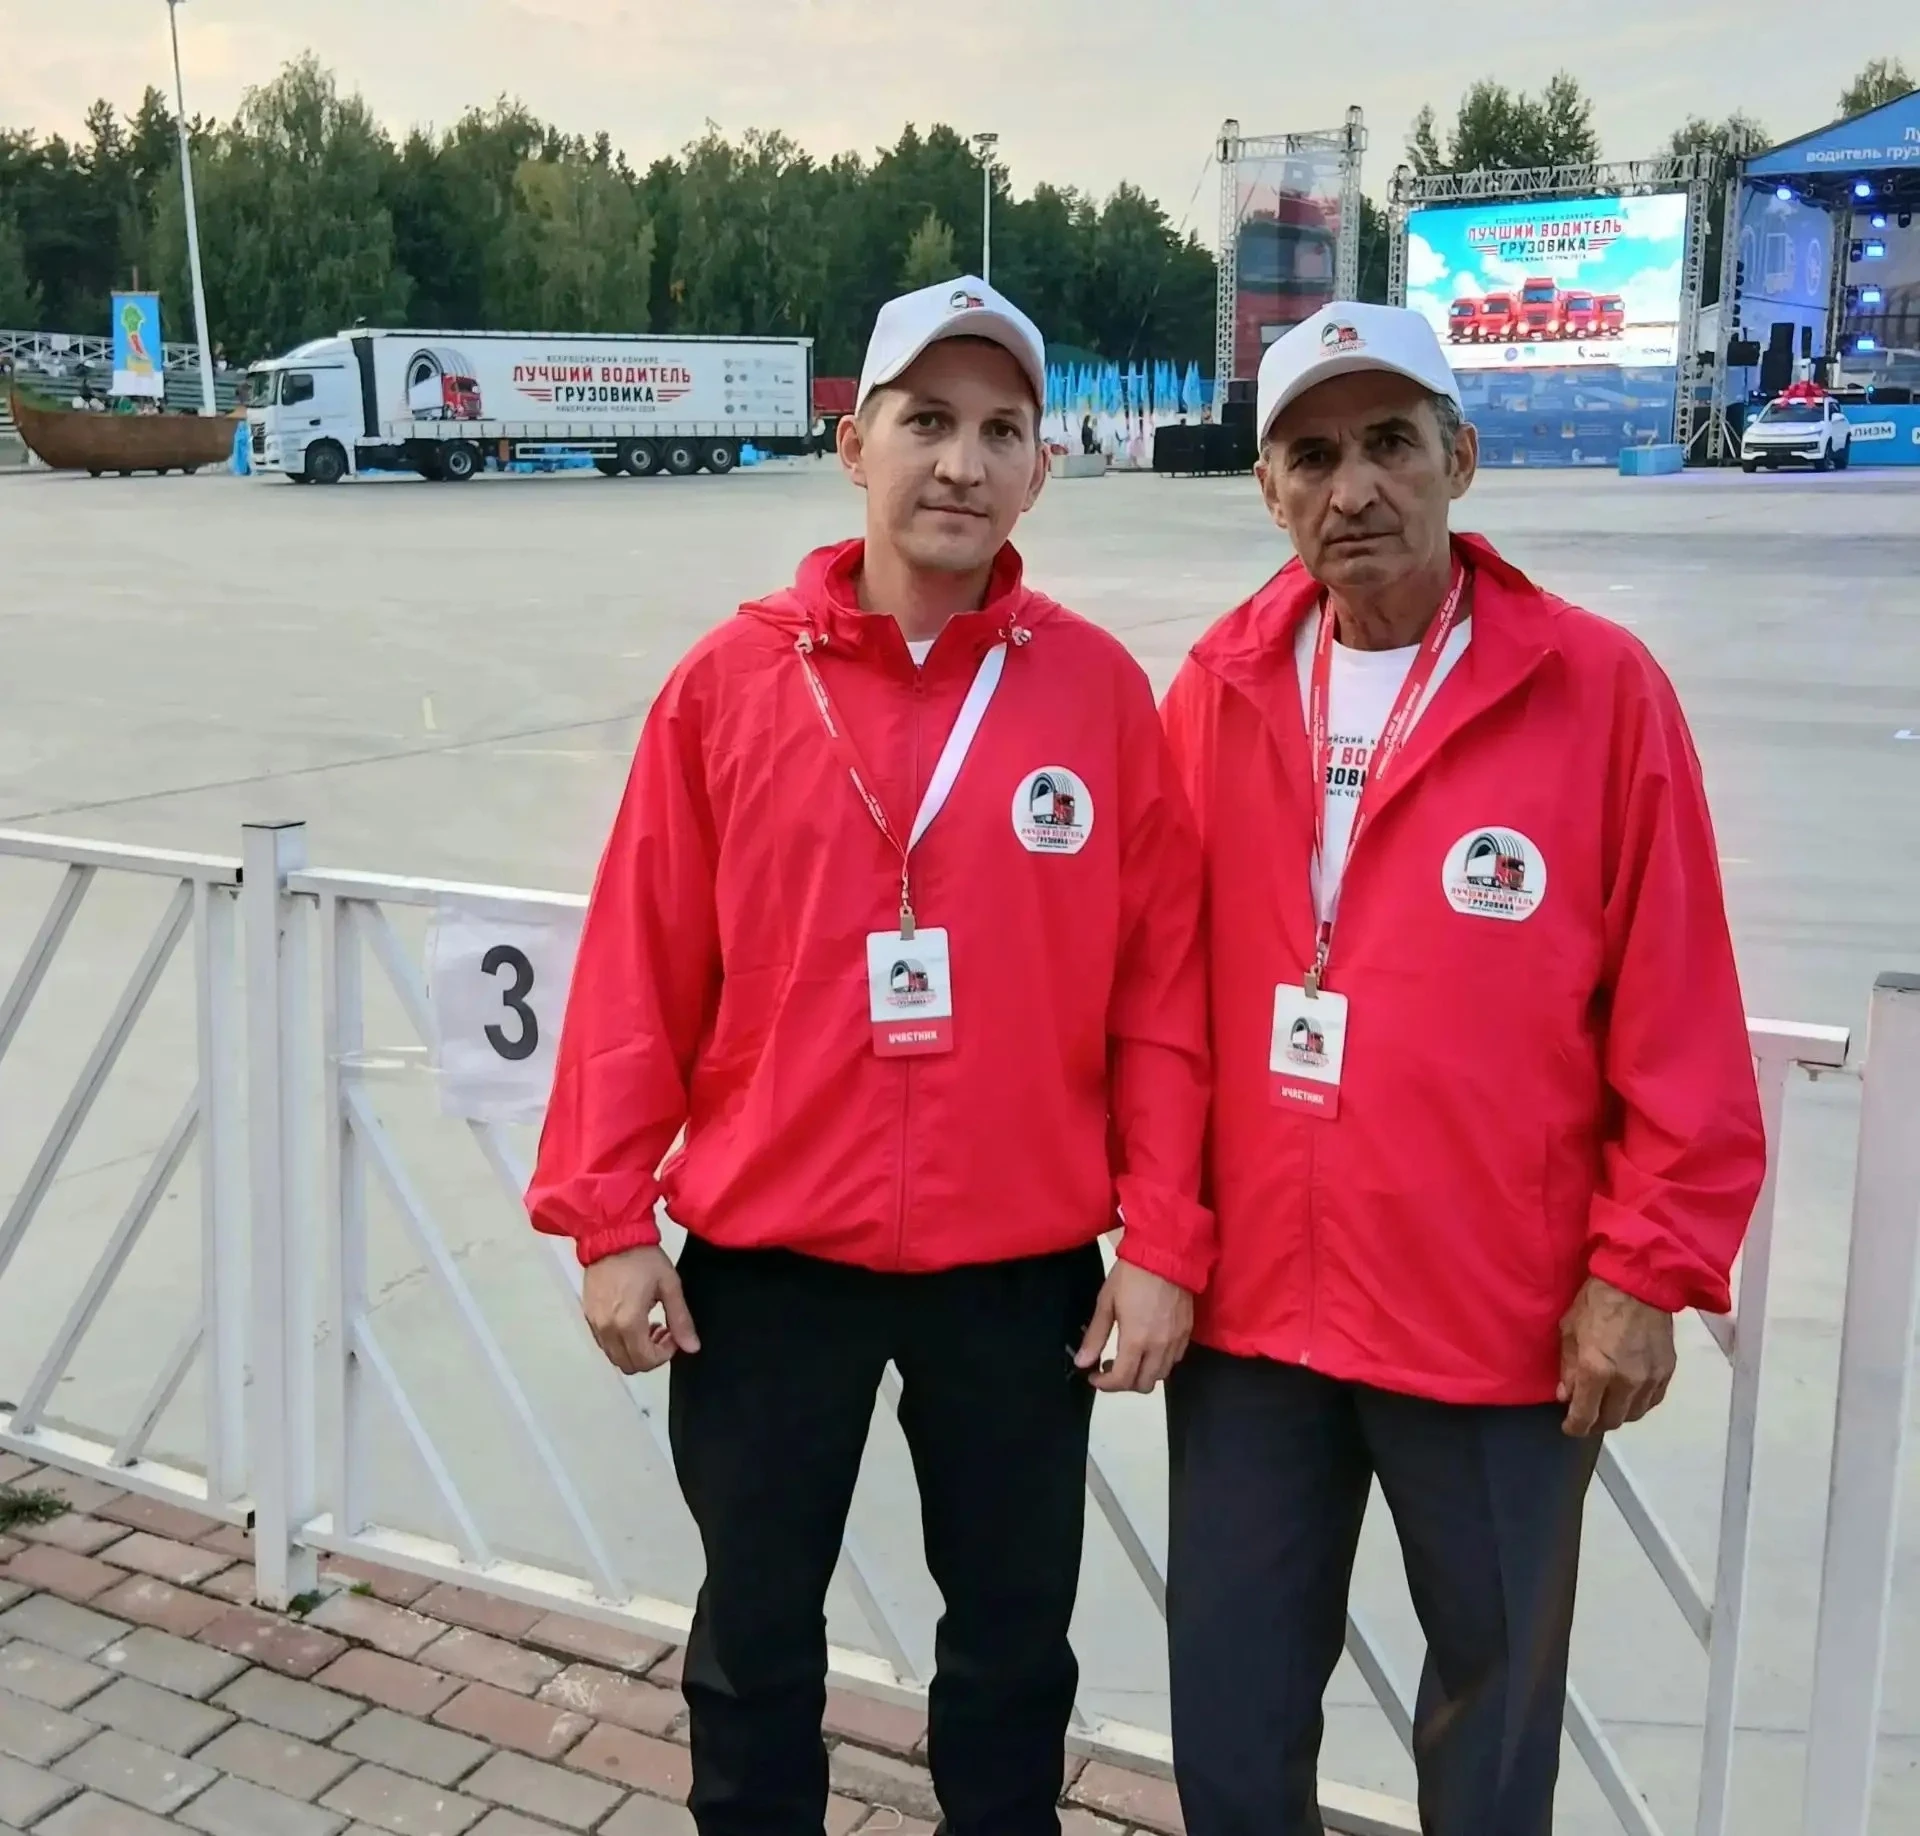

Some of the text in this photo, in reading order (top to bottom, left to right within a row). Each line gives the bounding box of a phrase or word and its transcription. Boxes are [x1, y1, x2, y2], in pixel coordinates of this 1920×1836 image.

[1806, 148, 1882, 164] водитель
[1541, 219, 1622, 238] ВОДИТЕЛЬ
[1500, 237, 1586, 256] ГРУЗОВИКА
[513, 364, 691, 384] ЛУЧШИЙ ВОДИТЕЛЬ
[555, 386, 654, 402] ГРУЗОВИКА
[1850, 426, 1892, 437] ЛИЗМ
[481, 944, 539, 1061] 3
